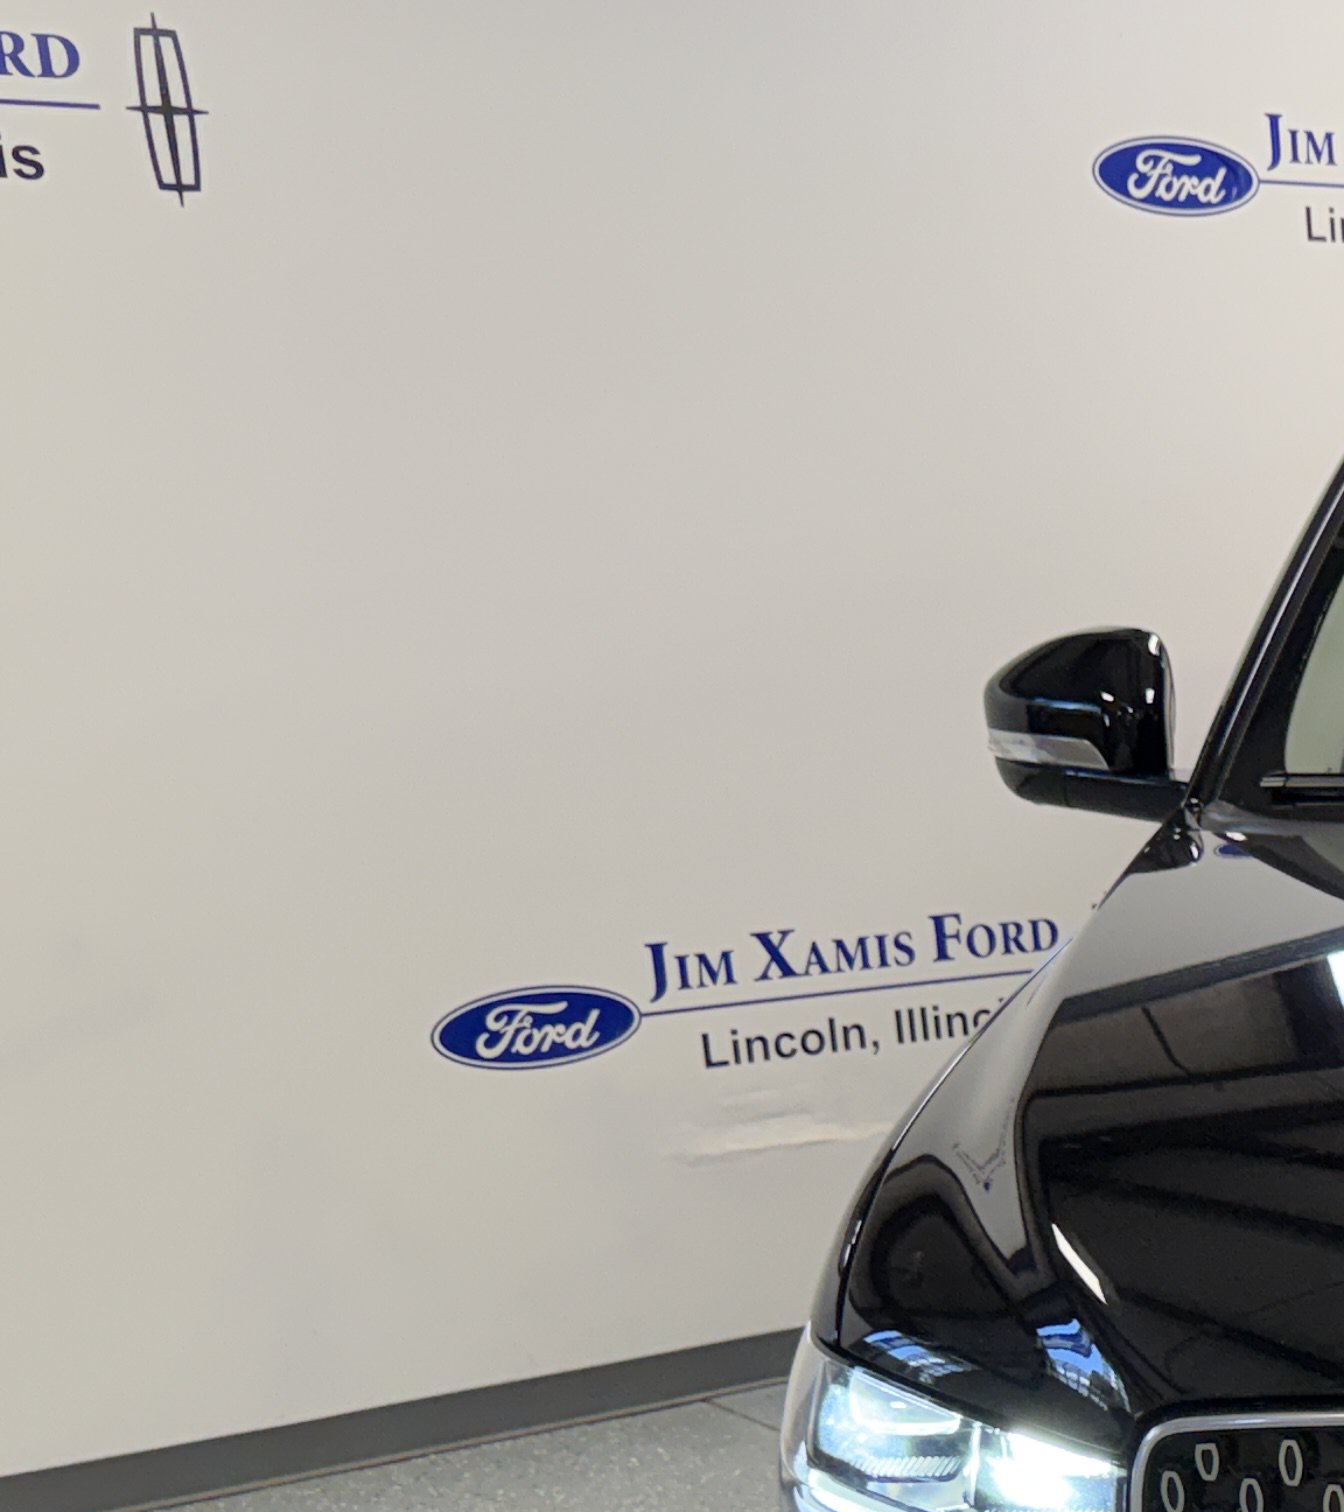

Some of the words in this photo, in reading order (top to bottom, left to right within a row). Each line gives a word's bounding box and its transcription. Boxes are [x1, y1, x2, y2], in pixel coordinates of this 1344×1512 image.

[1264, 112, 1337, 172] JIM
[1126, 149, 1226, 206] Ford
[644, 941, 736, 1002] JIM
[749, 928, 917, 981] XAMIS
[927, 912, 1060, 963] FORD
[475, 1001, 600, 1057] Ford
[701, 1016, 881, 1070] Lincoln,
[893, 998, 1004, 1046] Illin
